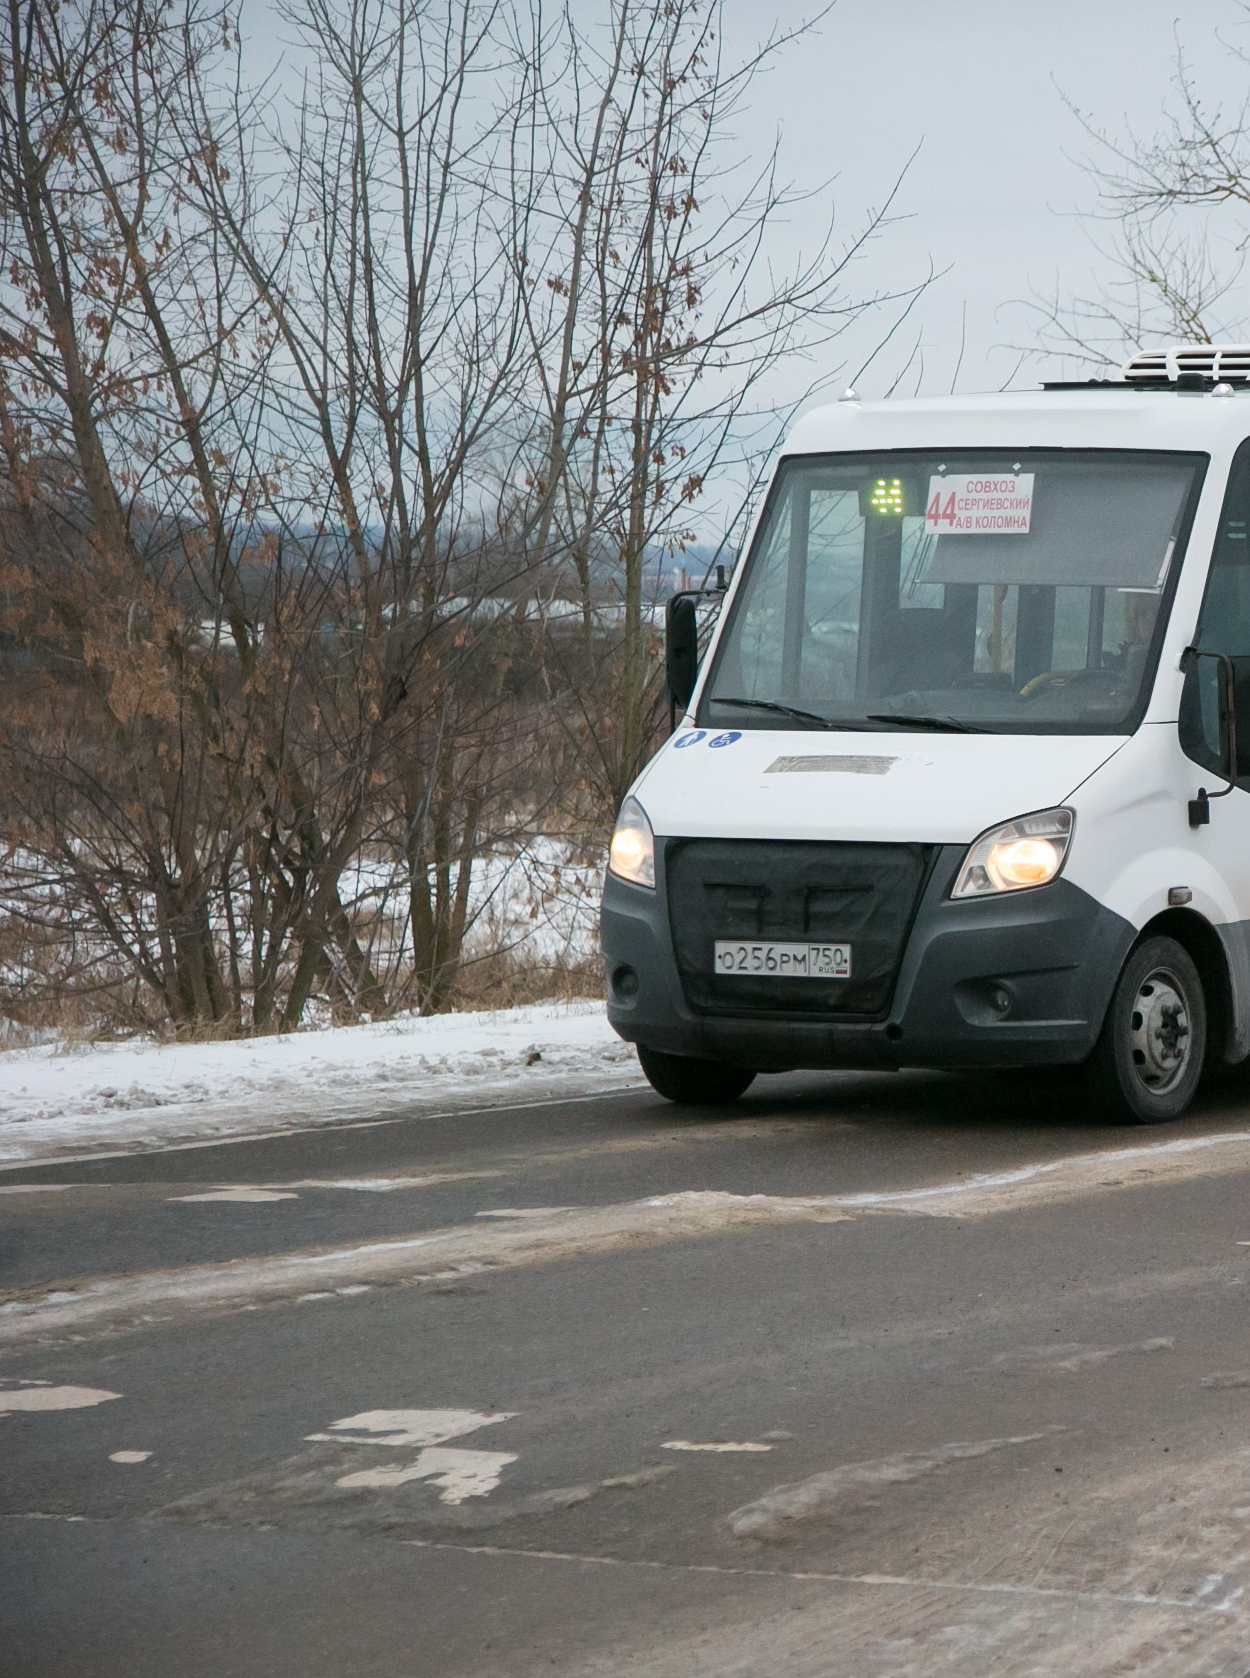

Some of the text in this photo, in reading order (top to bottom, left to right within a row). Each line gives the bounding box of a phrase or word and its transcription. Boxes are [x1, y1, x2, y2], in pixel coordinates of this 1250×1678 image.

[966, 480, 1016, 494] СОВХОЗ
[926, 491, 957, 527] 44
[957, 495, 1030, 511] СЕРГИЕВСКИЙ
[955, 516, 1028, 529] А/В КОЛОМНА
[810, 947, 844, 966] 750
[818, 966, 835, 974] RUS
